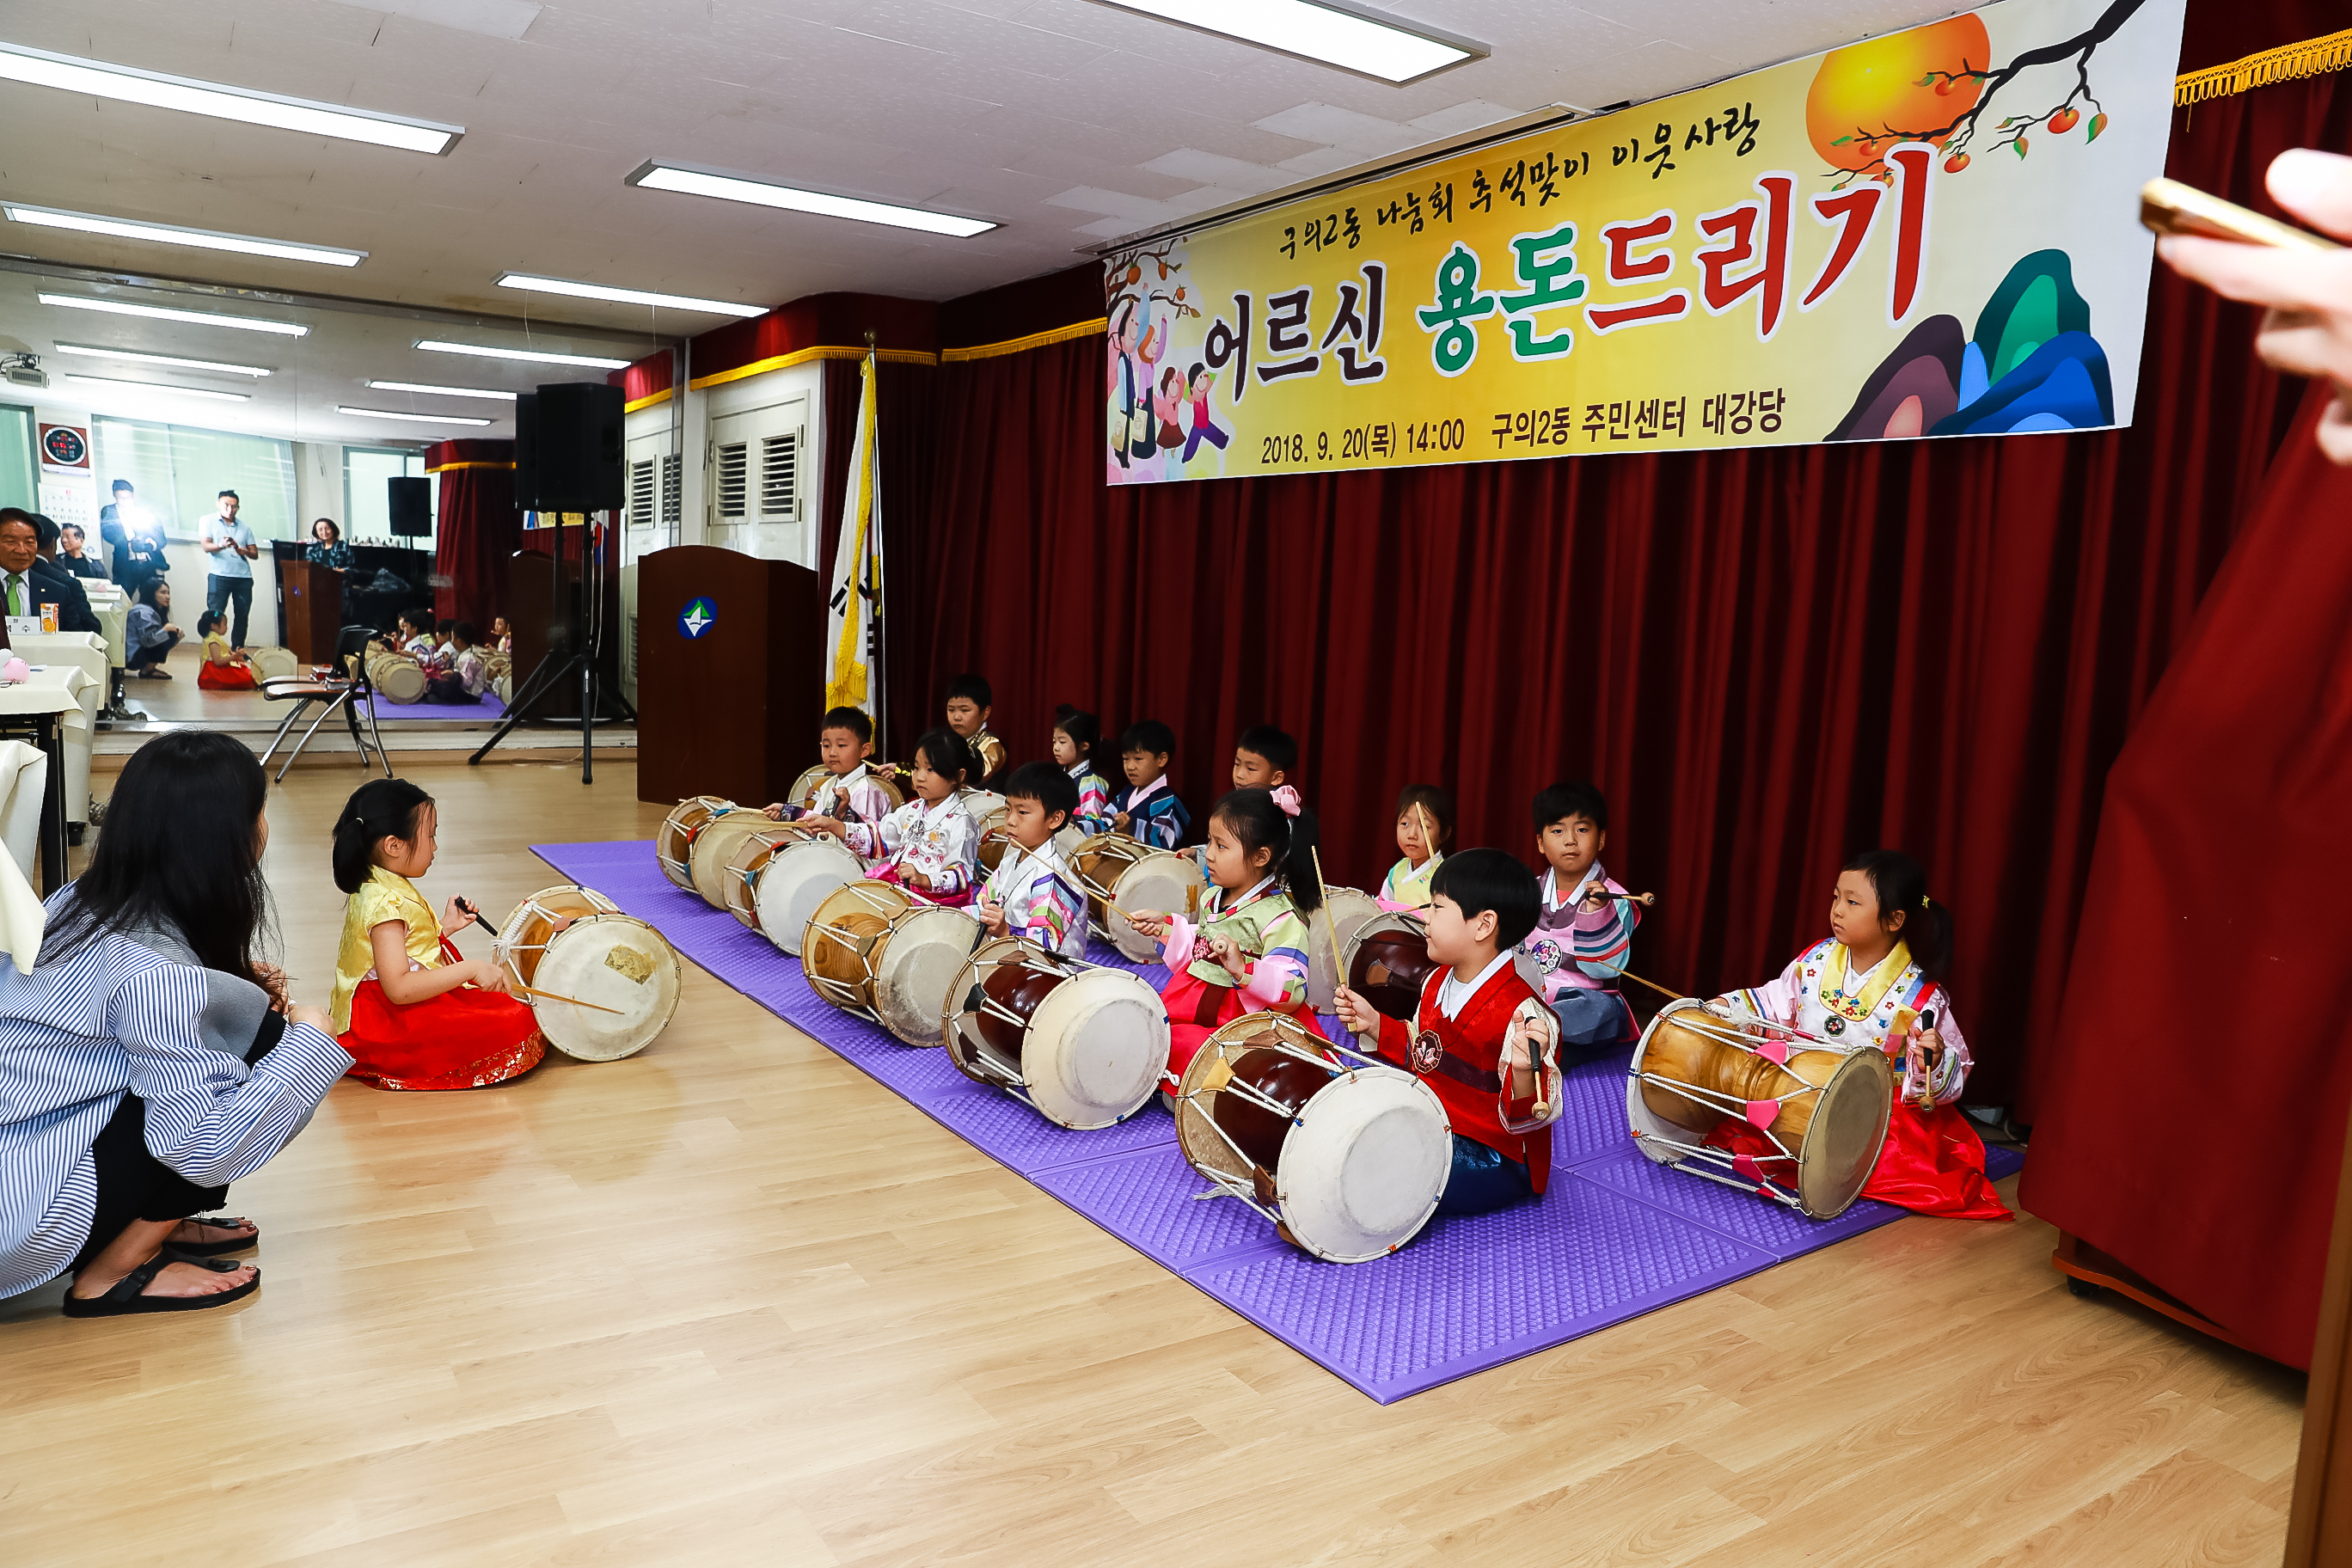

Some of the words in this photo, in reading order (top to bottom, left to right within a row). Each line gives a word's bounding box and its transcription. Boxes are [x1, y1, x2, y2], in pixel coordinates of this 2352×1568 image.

[1279, 207, 1361, 260] 구의2동
[1376, 181, 1453, 235] 나눔회
[1468, 151, 1589, 213] 추석맞이
[1204, 265, 1385, 404] 어르신
[1261, 436, 1308, 464] 2018.
[1317, 431, 1333, 462] 9.
[1342, 421, 1396, 460] 20(목)
[1406, 418, 1465, 454] 14:00
[1491, 406, 1571, 450] 구의2동
[1582, 395, 1686, 442] 주민센터
[1701, 388, 1786, 436] 대강당
